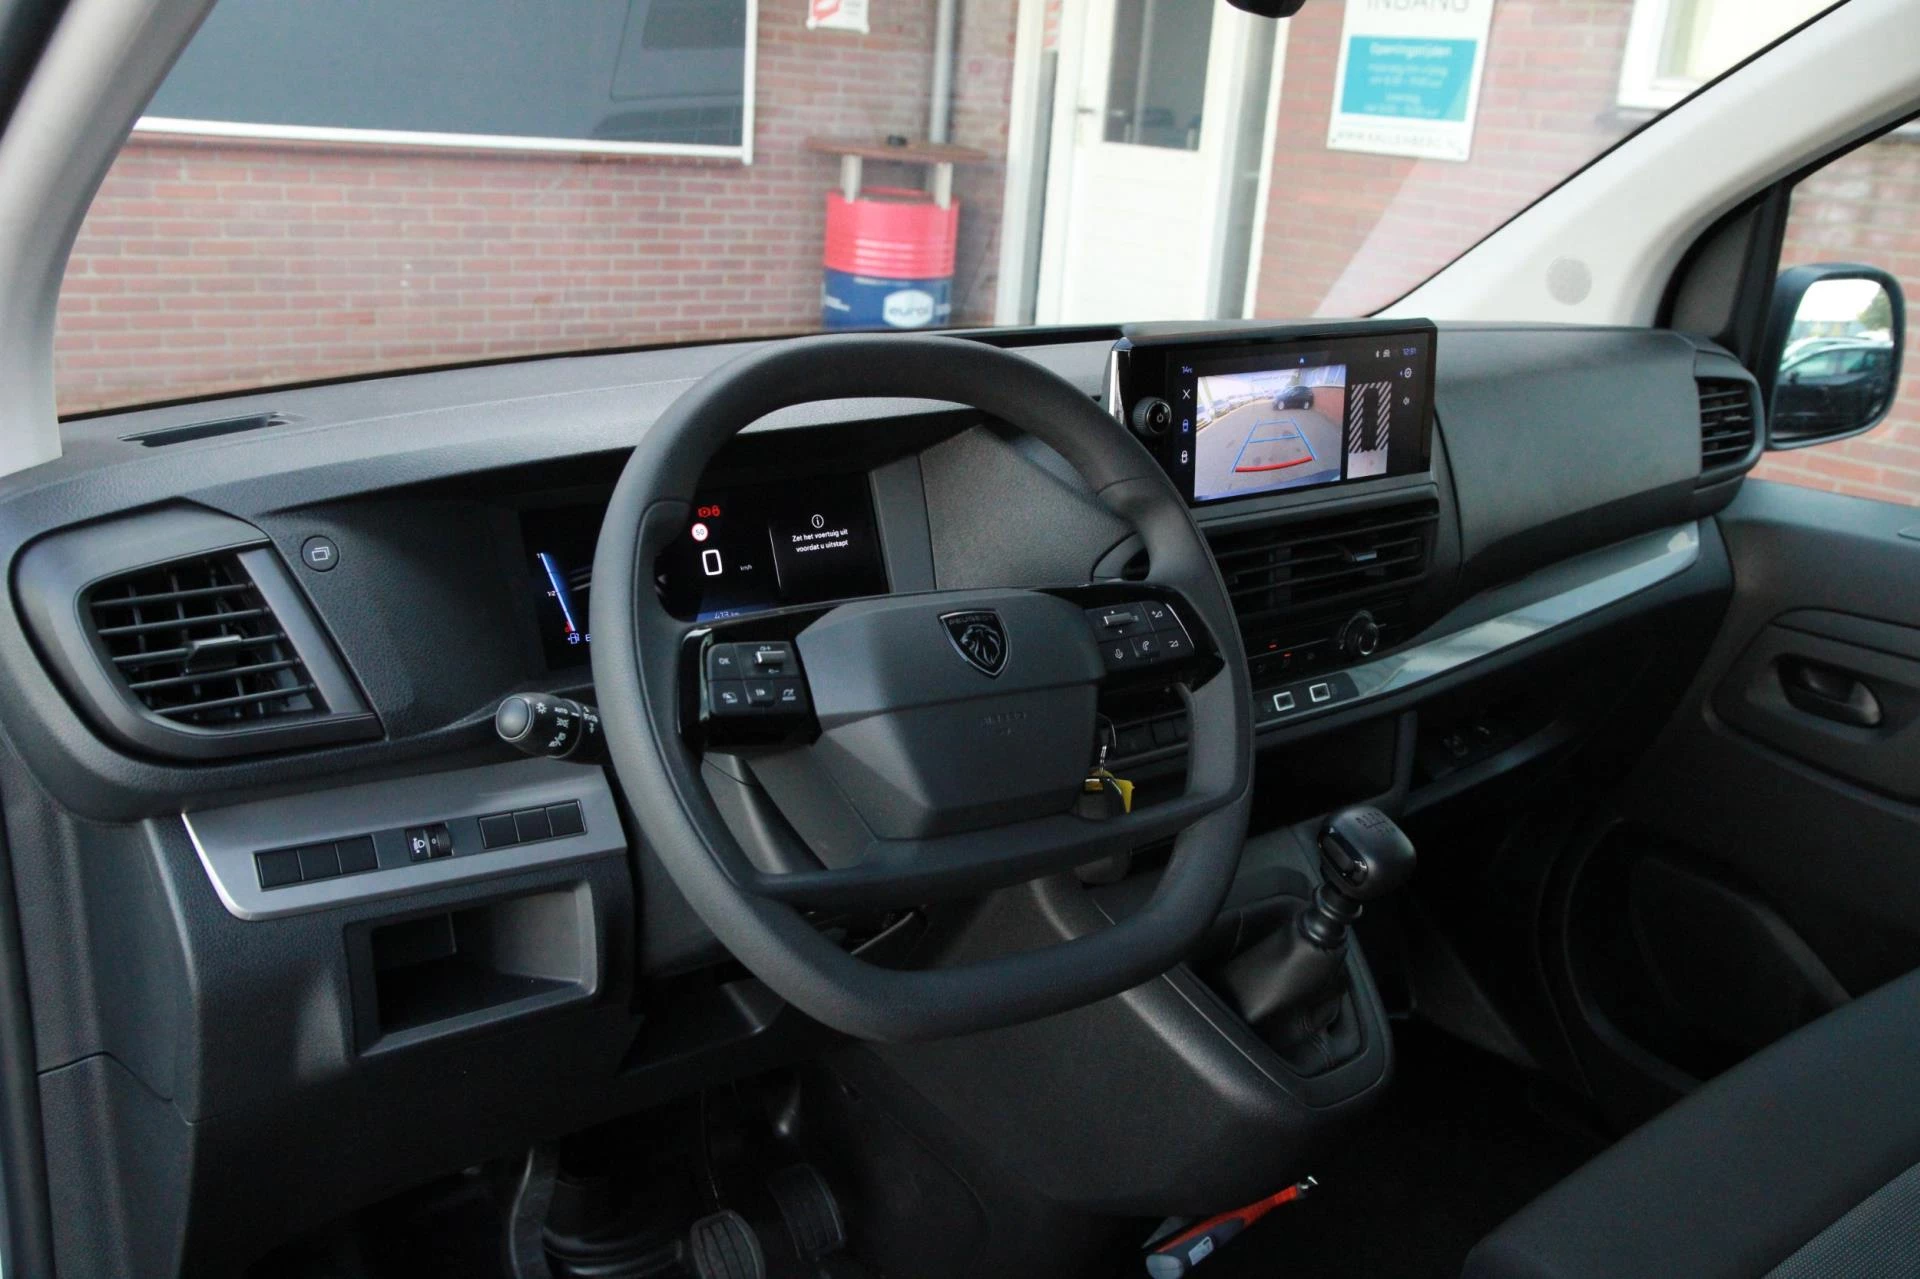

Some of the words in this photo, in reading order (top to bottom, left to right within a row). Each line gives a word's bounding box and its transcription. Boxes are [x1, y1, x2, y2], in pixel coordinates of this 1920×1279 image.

[792, 534, 803, 542] Zet
[803, 533, 814, 541] het
[814, 529, 840, 539] voertuig
[839, 528, 848, 536] uit
[796, 543, 820, 552] voordat
[825, 539, 848, 548] uitstapt
[702, 549, 722, 576] 0
[718, 657, 731, 665] OK
